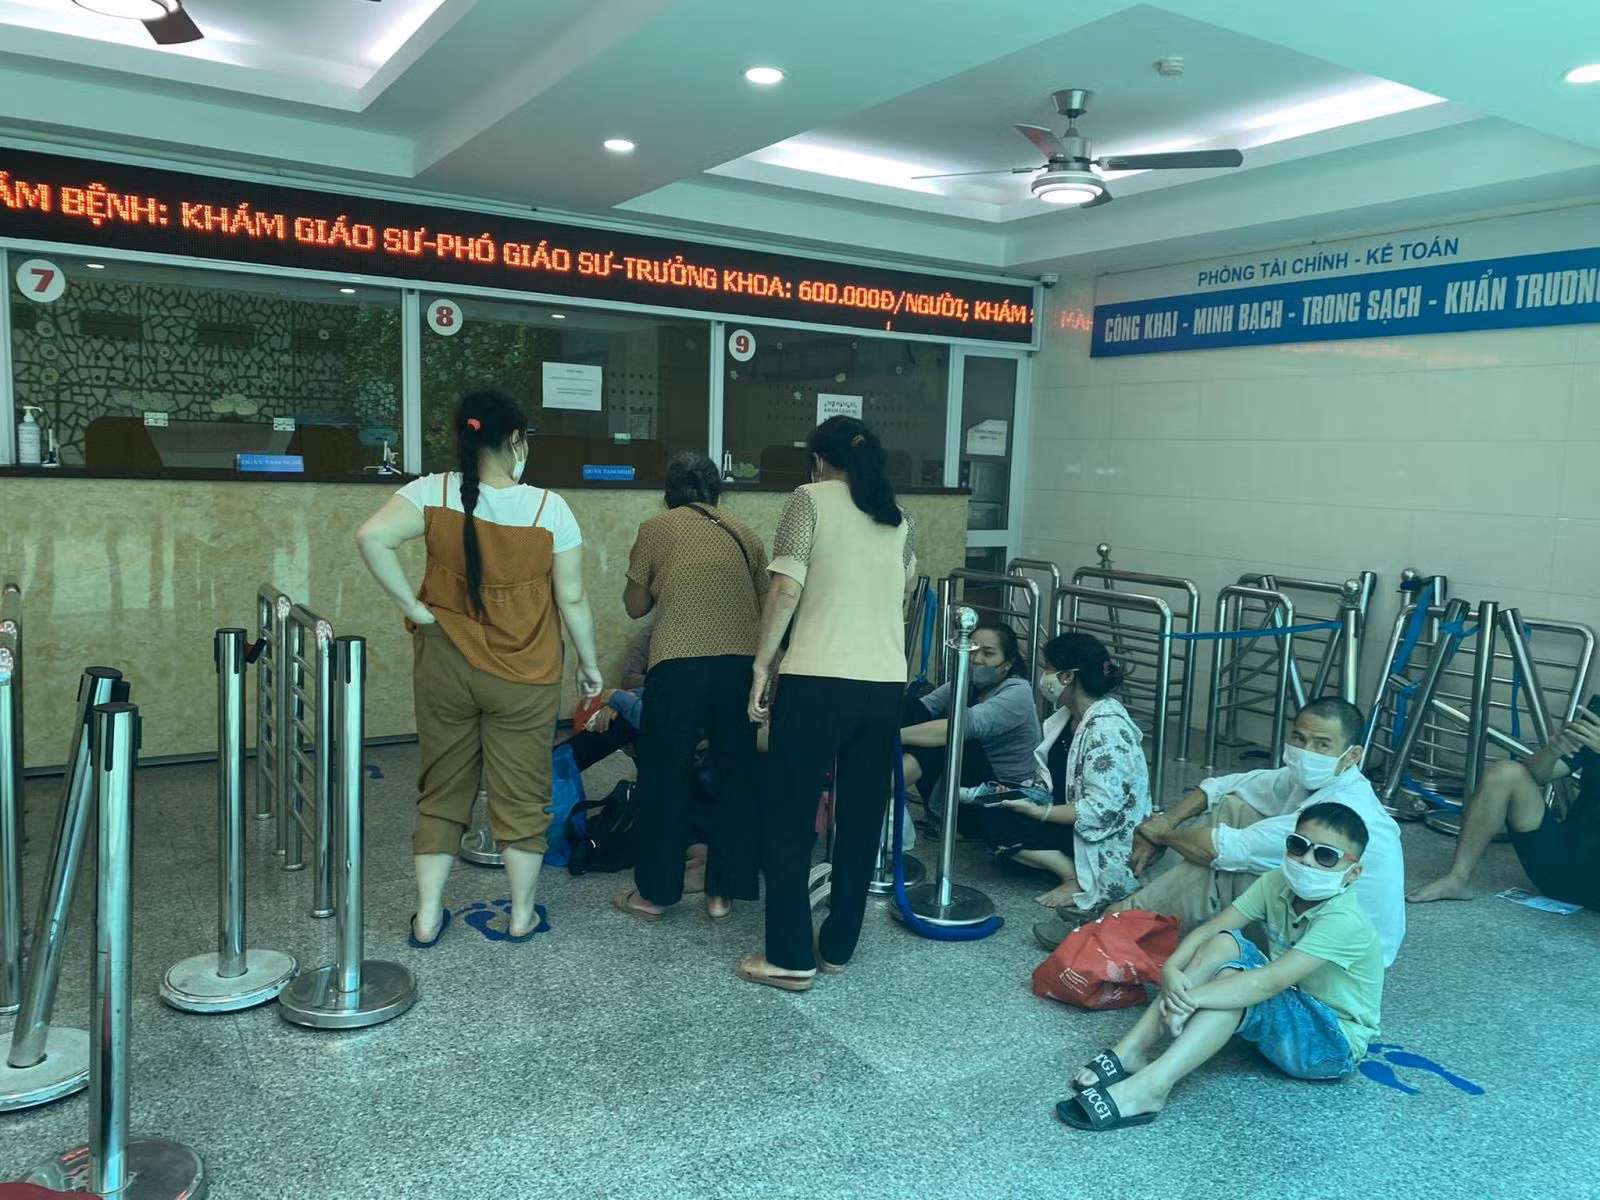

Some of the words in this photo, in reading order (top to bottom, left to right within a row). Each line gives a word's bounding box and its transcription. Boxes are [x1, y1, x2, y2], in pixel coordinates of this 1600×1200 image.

[60, 182, 168, 226] BỆNH:
[181, 203, 285, 240] KHÁM
[295, 214, 375, 250] GIÁO
[503, 239, 571, 271] GIÁO
[723, 269, 792, 299] KHOA:
[974, 299, 1027, 324] KHÁM
[1198, 264, 1255, 287] PHÒNG
[1260, 257, 1287, 278] TÀI
[1292, 251, 1349, 274] CHÍNH
[1400, 235, 1459, 261] TOÁN
[30, 268, 55, 293] 7
[435, 306, 455, 328] 8
[1144, 310, 1179, 339] KHAI
[1193, 304, 1235, 335] MINH
[1238, 299, 1284, 335] BẠCH
[1302, 291, 1361, 327] TRONG
[1367, 285, 1423, 325] SẠCH
[1444, 268, 1509, 315] KHẨN
[734, 335, 750, 354] 9
